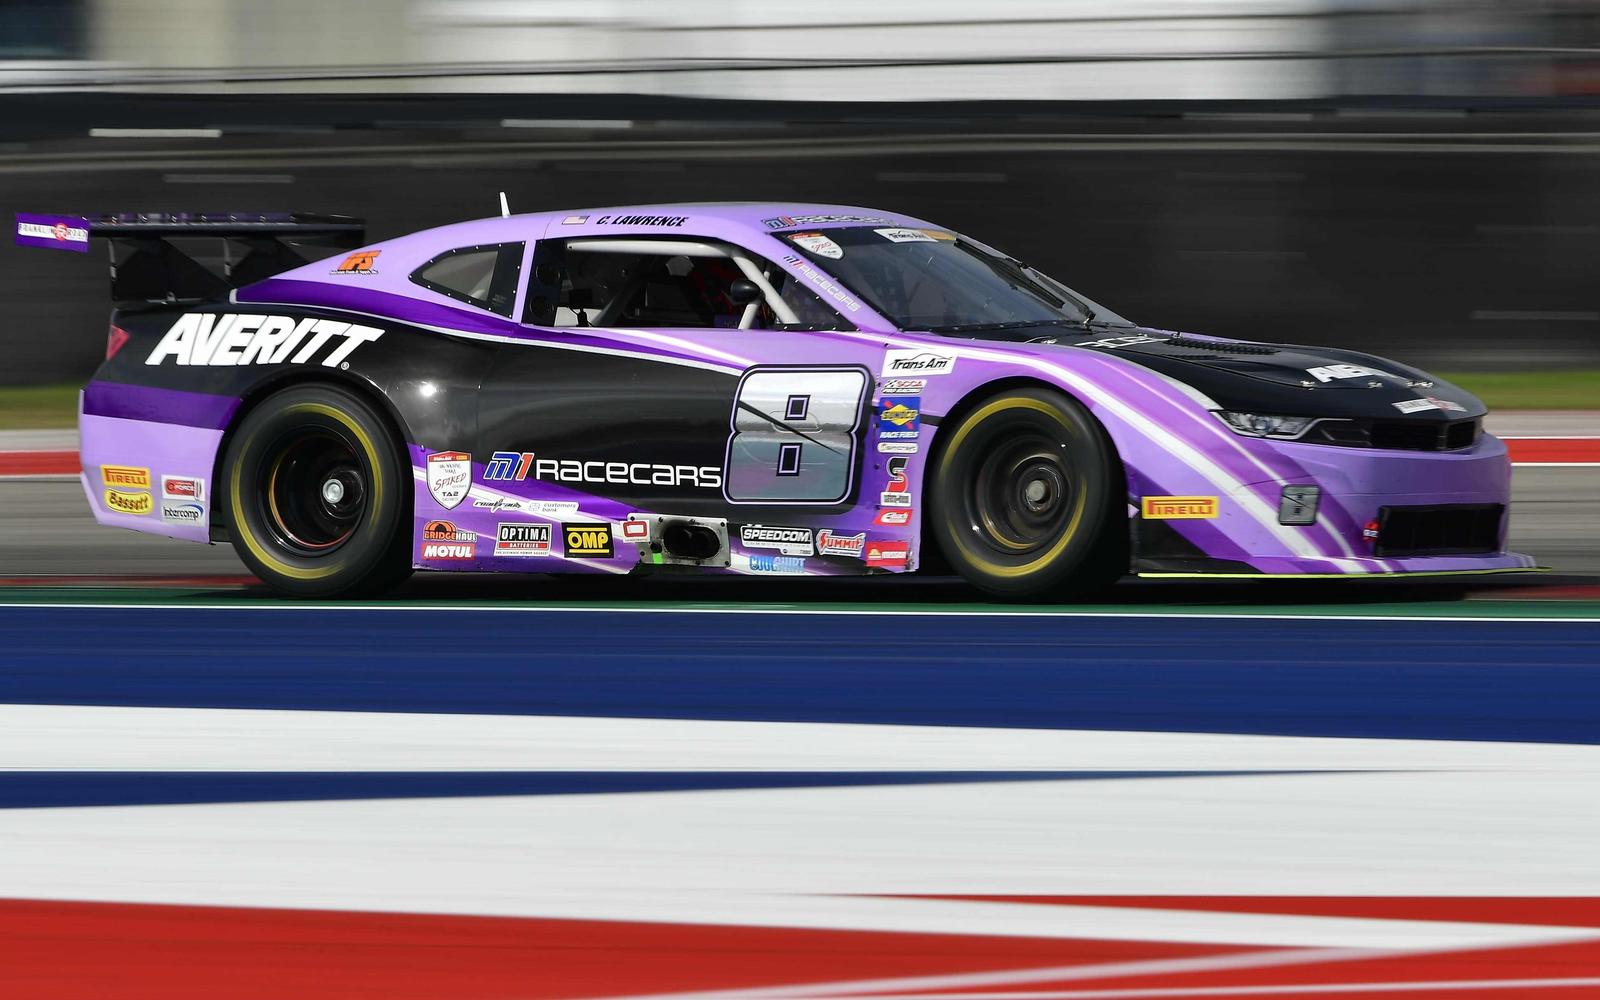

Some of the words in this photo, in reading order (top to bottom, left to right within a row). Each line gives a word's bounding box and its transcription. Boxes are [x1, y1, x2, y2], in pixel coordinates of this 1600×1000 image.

[611, 215, 689, 227] LAWRENCE
[145, 313, 385, 367] AVERITT
[891, 359, 924, 370] Trans
[925, 358, 948, 369] Am
[722, 365, 873, 506] 8
[104, 467, 147, 485] PIRELLI
[1147, 499, 1214, 515] PIRELLI
[501, 527, 548, 541] OPTIMA
[567, 531, 609, 549] OMP
[743, 529, 811, 543] SPEEDCOM
[424, 545, 472, 558] MOTUL
